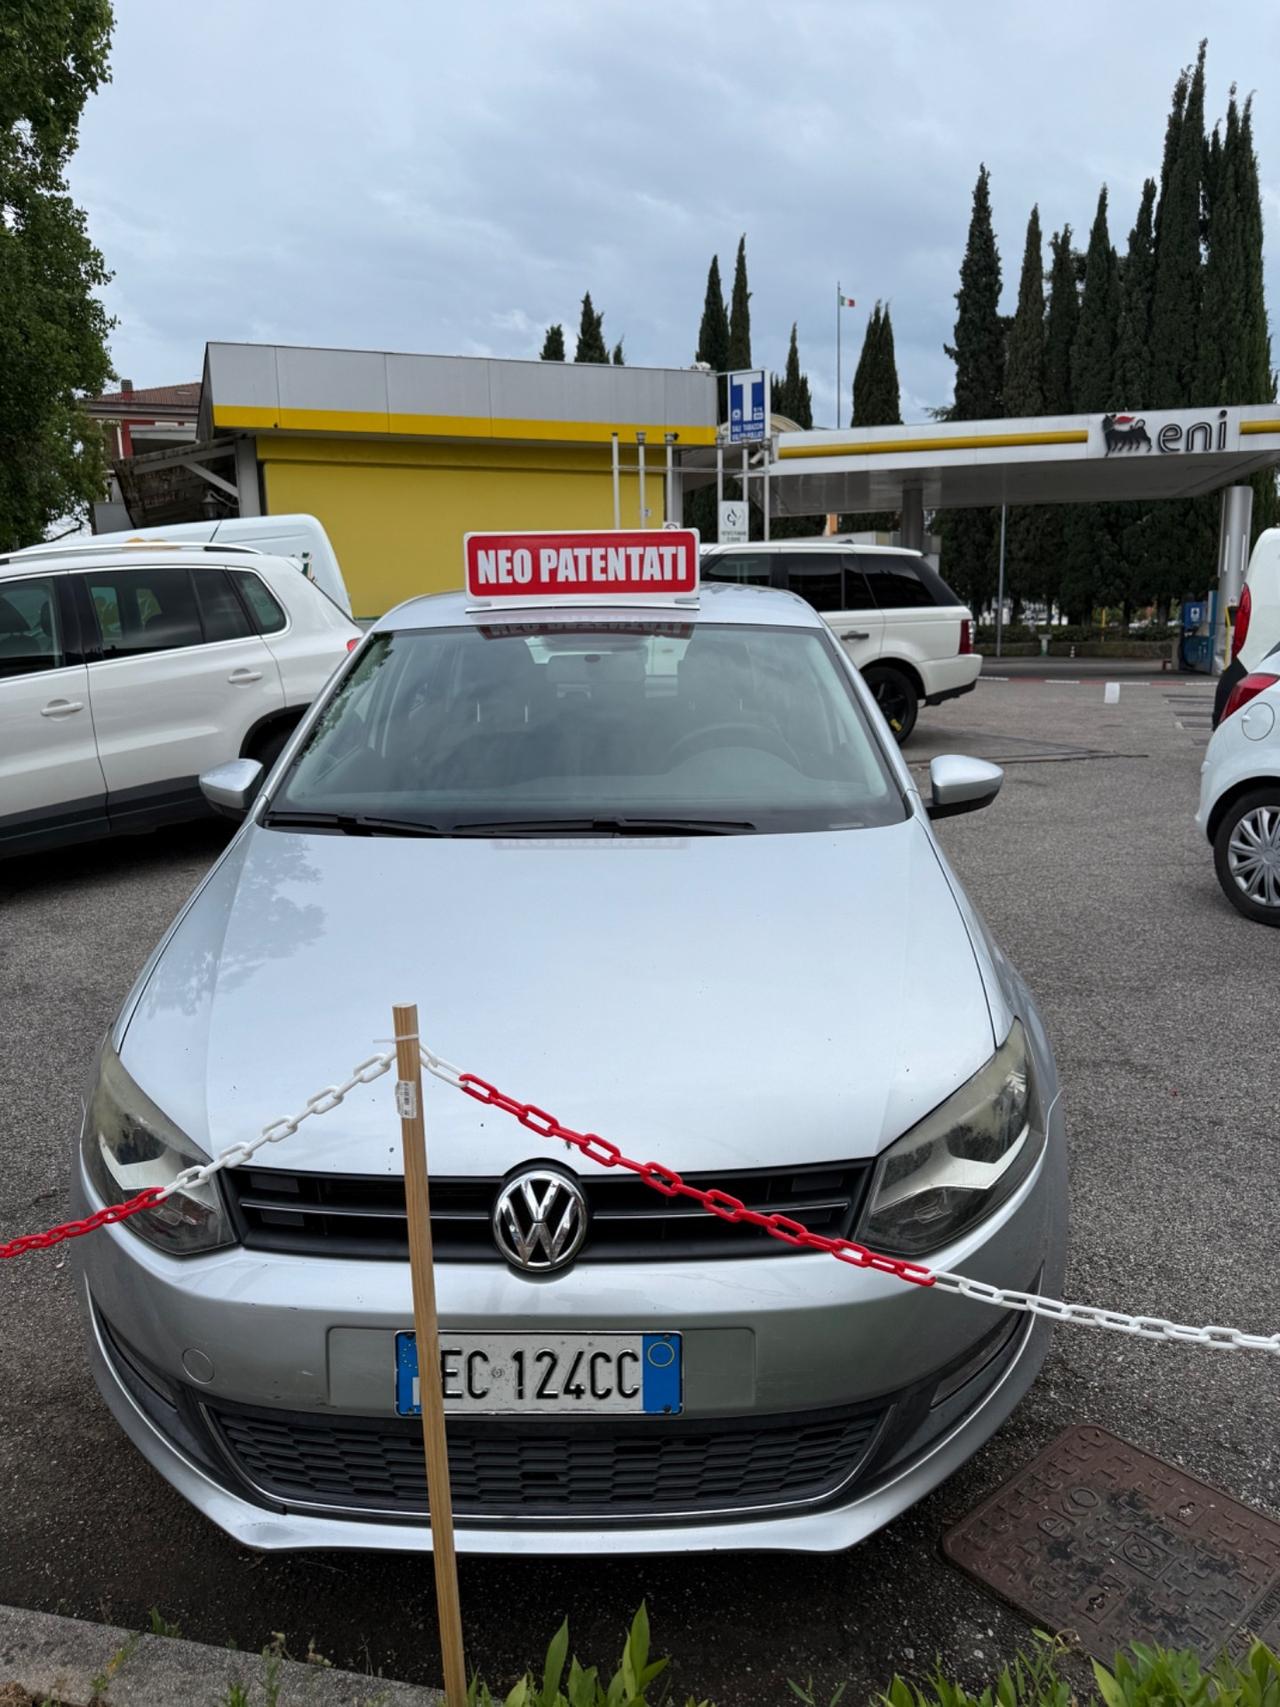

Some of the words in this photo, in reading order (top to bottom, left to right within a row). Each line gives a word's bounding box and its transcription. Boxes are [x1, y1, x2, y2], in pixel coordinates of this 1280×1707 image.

[1158, 409, 1227, 453] eni
[477, 549, 532, 584] NEO
[540, 546, 686, 583] PATENTATI
